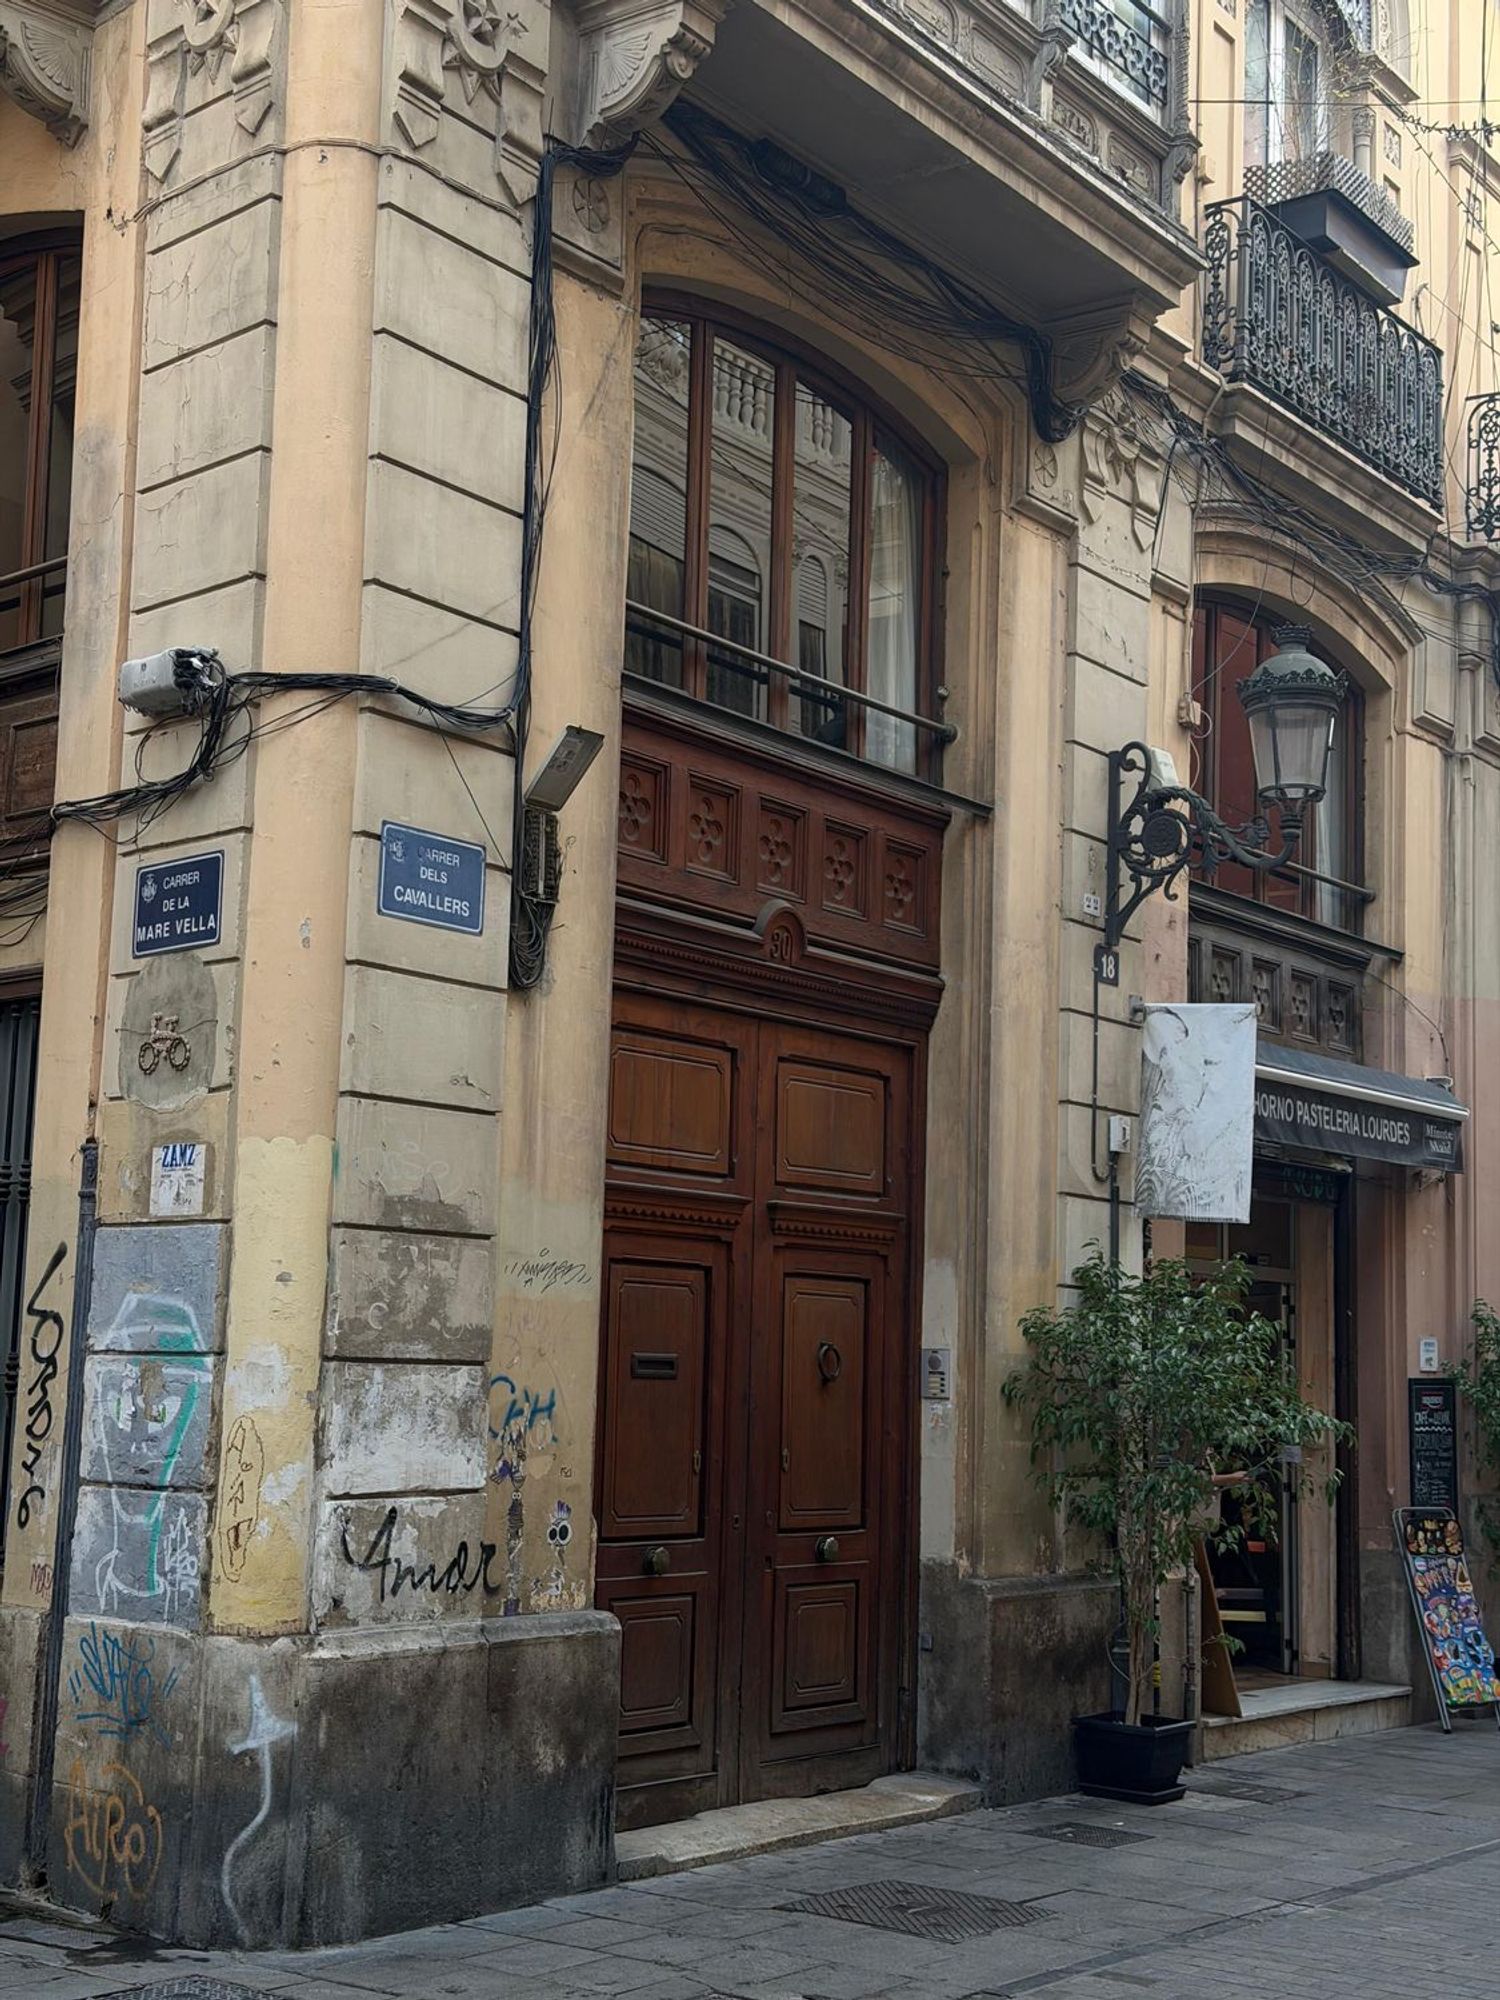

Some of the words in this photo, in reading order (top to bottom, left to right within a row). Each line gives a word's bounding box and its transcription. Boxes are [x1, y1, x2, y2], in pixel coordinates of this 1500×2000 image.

[163, 871, 200, 889] CARRER
[420, 867, 448, 884] DELS
[162, 899, 175, 912] DE
[178, 896, 190, 909] LA
[394, 886, 470, 917] CAVALLERS
[137, 921, 170, 942] MARE
[175, 914, 216, 935] VELLA
[1101, 954, 1115, 979] 18
[1254, 1092, 1294, 1122] HORNO
[1362, 1115, 1411, 1145] LOURDES
